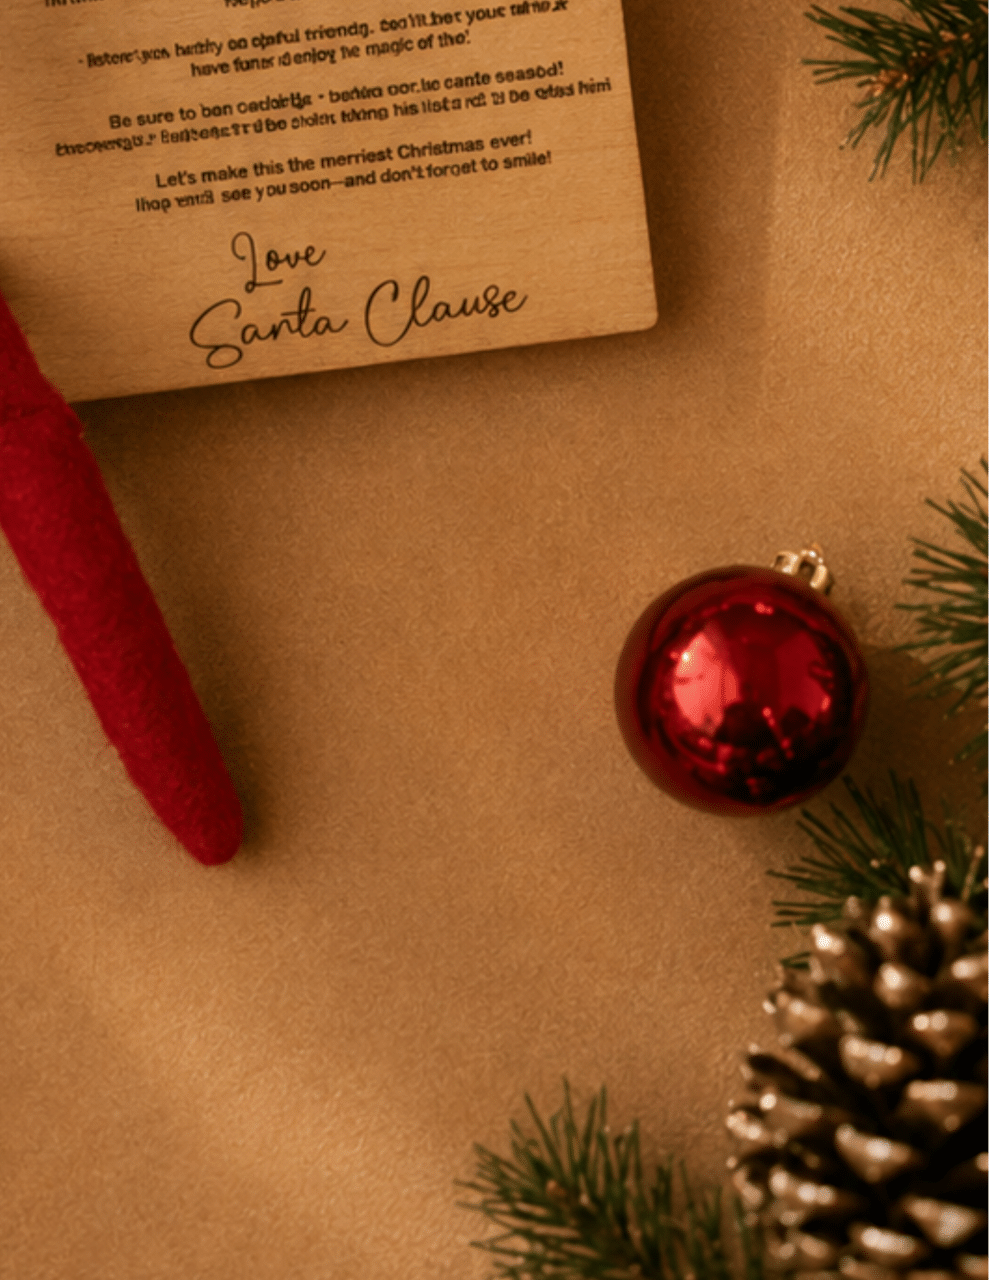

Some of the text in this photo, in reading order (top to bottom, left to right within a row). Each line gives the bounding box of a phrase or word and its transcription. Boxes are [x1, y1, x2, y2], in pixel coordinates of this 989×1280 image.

[417, 34, 434, 50] of
[109, 115, 131, 129] Be
[137, 112, 174, 126] sure
[179, 108, 197, 121] to
[156, 130, 531, 188] Let's make this the merriest Christmas ever!
[480, 158, 499, 171] to
[503, 150, 551, 169] smile!
[230, 231, 327, 294] Love
[189, 275, 528, 369] Santa Clause
